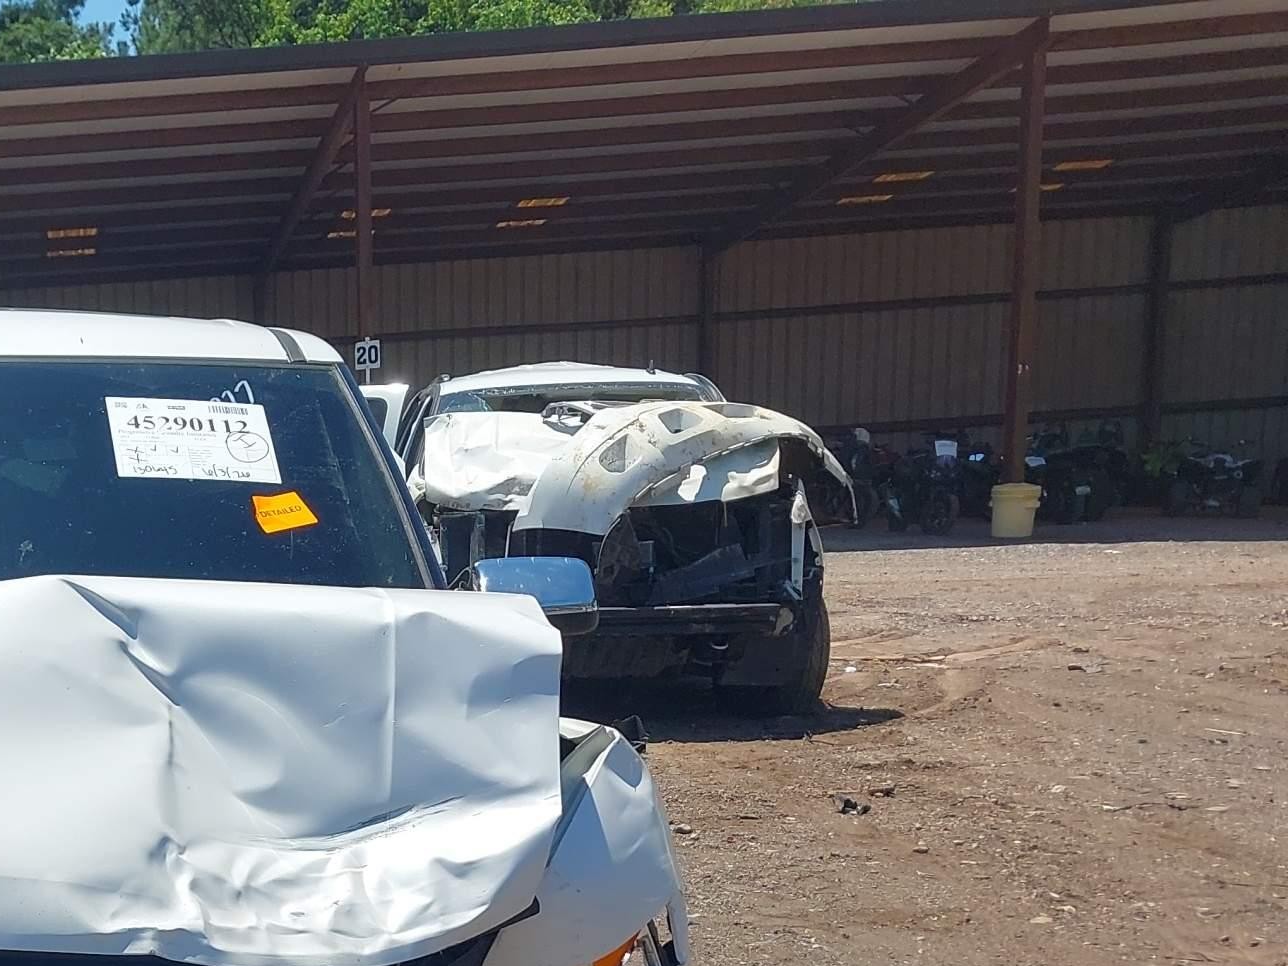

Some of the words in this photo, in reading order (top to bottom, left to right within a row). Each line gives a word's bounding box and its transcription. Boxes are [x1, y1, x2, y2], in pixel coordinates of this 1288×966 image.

[357, 344, 378, 365] 20
[127, 415, 250, 433] 45290112
[258, 505, 302, 518] DETAILED
